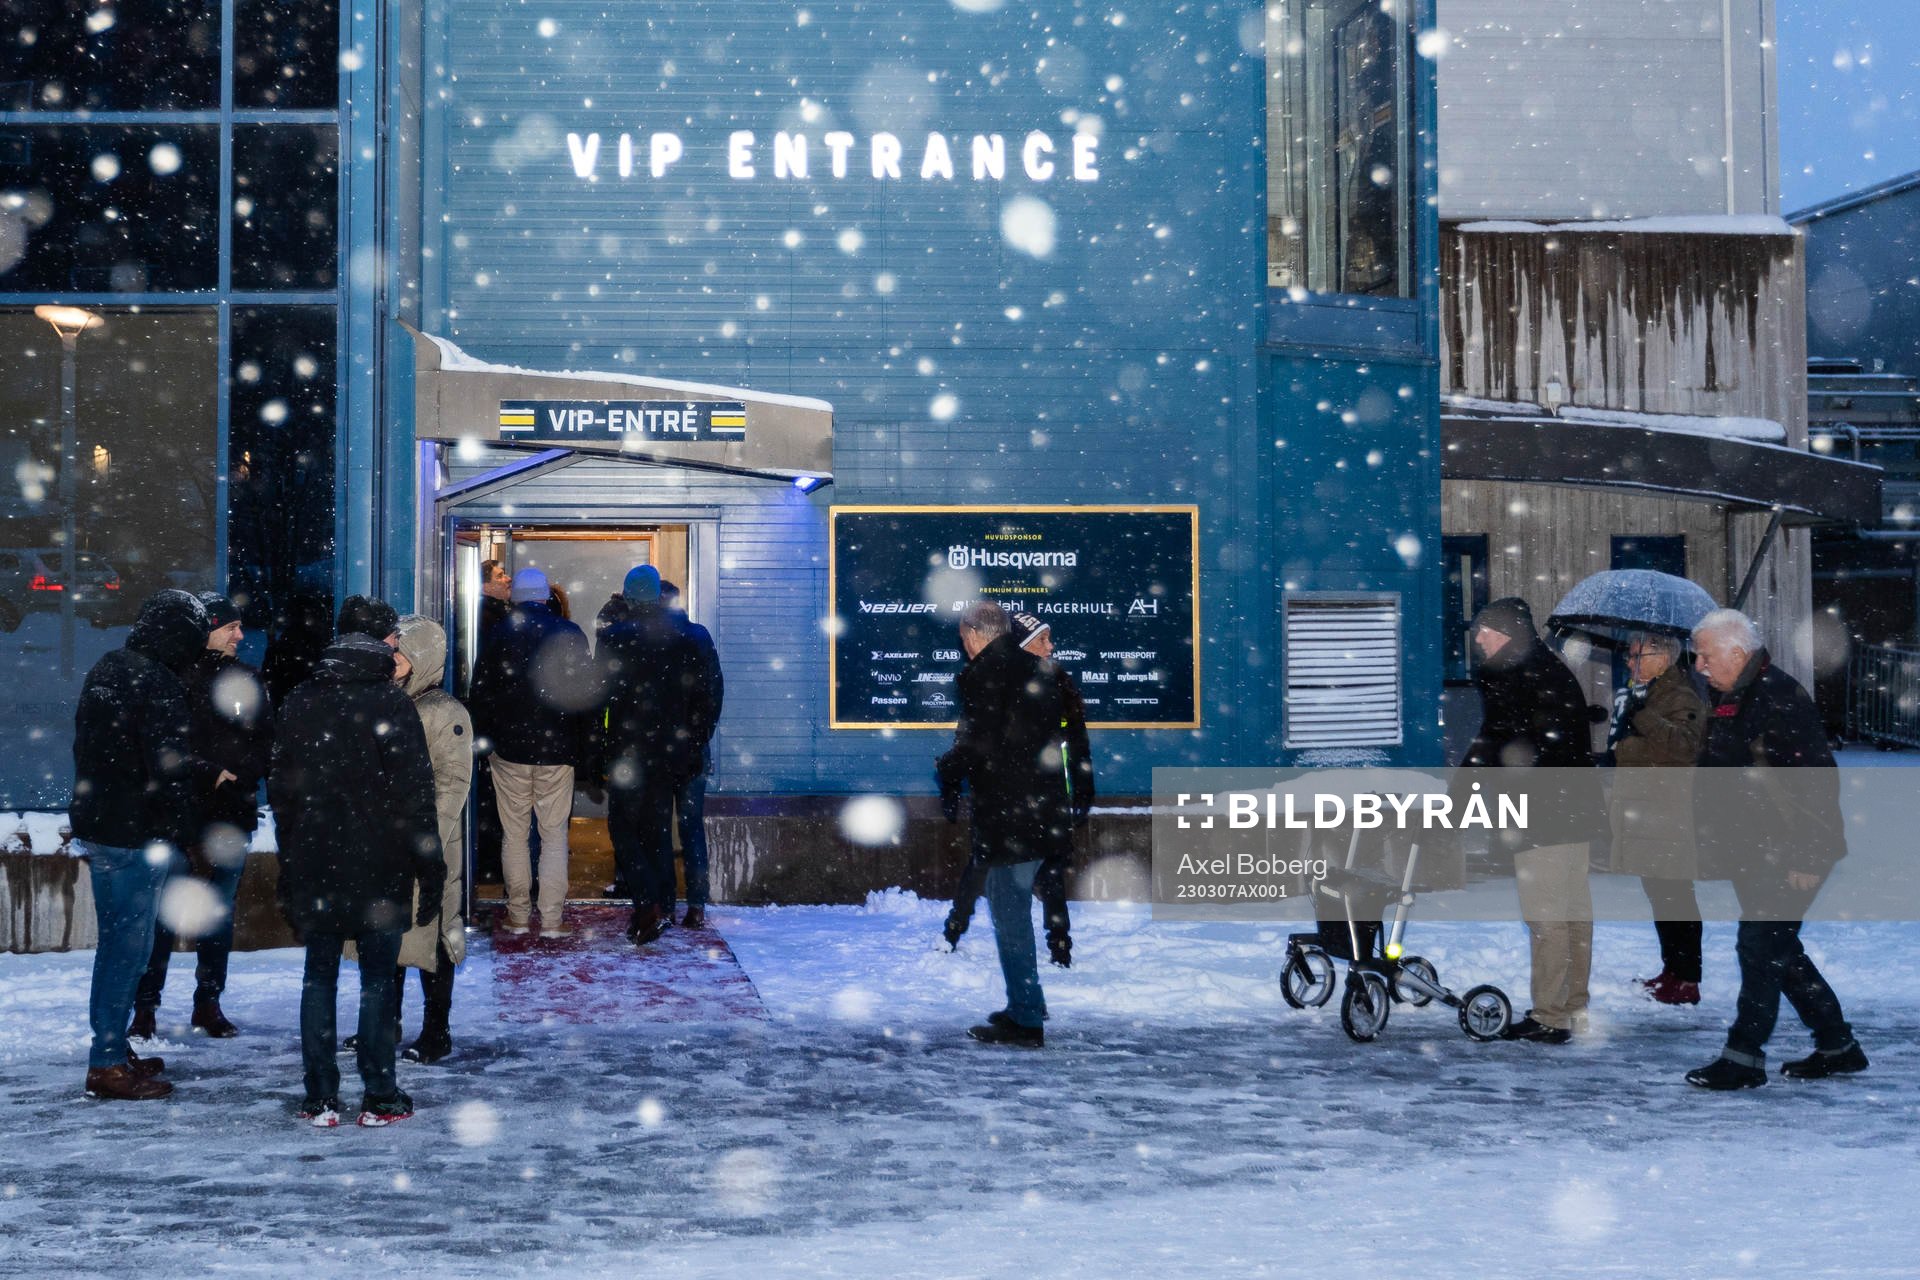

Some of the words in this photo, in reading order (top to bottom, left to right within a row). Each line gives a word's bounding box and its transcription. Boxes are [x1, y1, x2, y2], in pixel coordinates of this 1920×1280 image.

[567, 131, 683, 179] VIP
[728, 130, 1099, 181] ENTRANCE
[548, 404, 698, 433] VIP-ENTRÉ
[971, 548, 1077, 569] Husqvarna
[1037, 603, 1114, 614] FAGERHULT
[1128, 599, 1158, 614] AH
[935, 651, 958, 660] EAB
[1107, 651, 1157, 659] INTERSPORT
[1117, 672, 1147, 682] nybergs
[1148, 672, 1158, 681] bil
